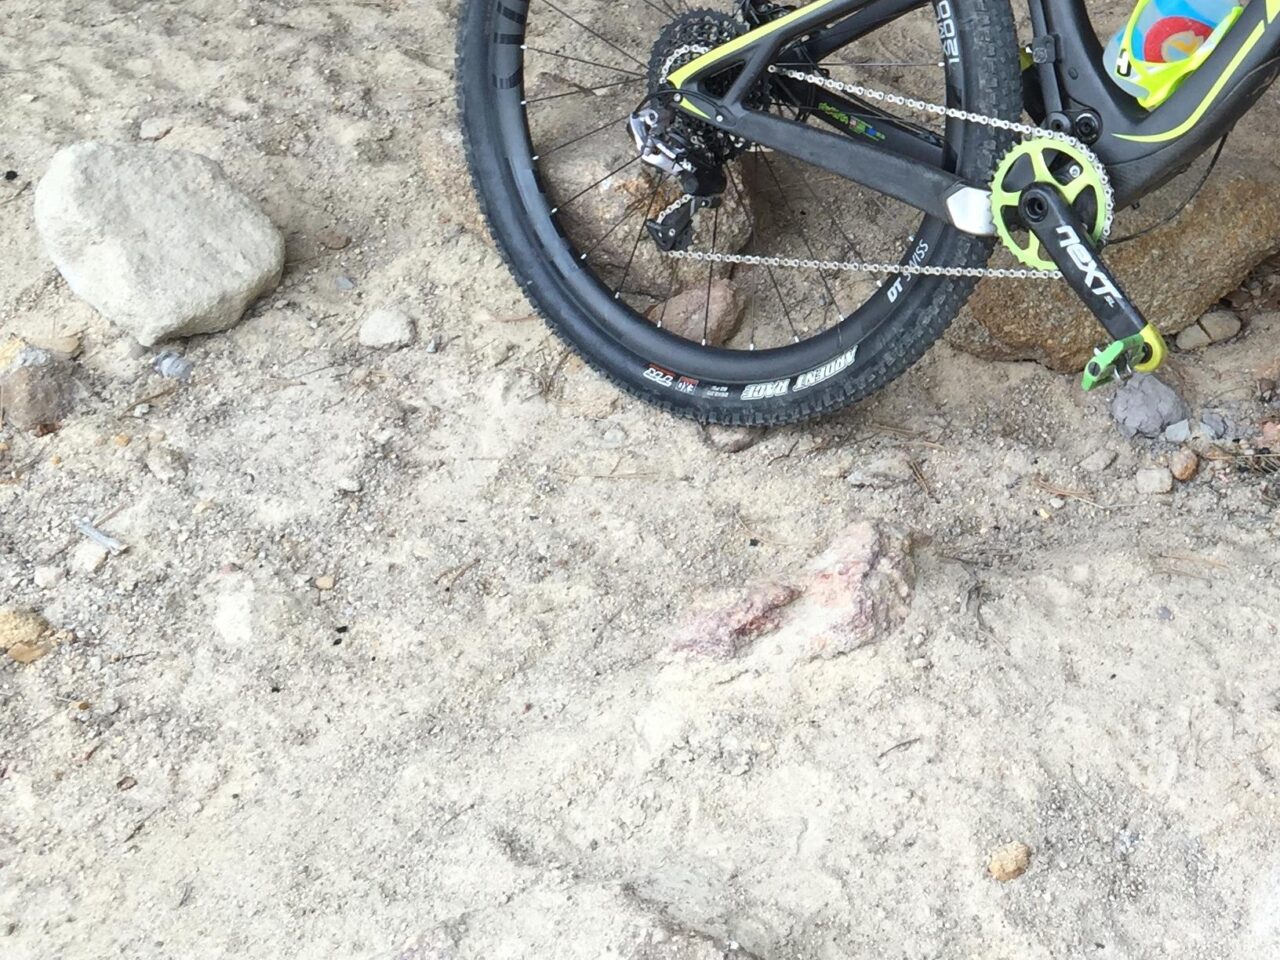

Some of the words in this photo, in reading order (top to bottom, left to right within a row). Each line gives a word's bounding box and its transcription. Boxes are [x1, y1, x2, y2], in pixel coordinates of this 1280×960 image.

[939, 0, 959, 64] 1200
[887, 277, 903, 303] DT
[793, 345, 858, 392] ARDENT
[741, 378, 790, 401] RACE
